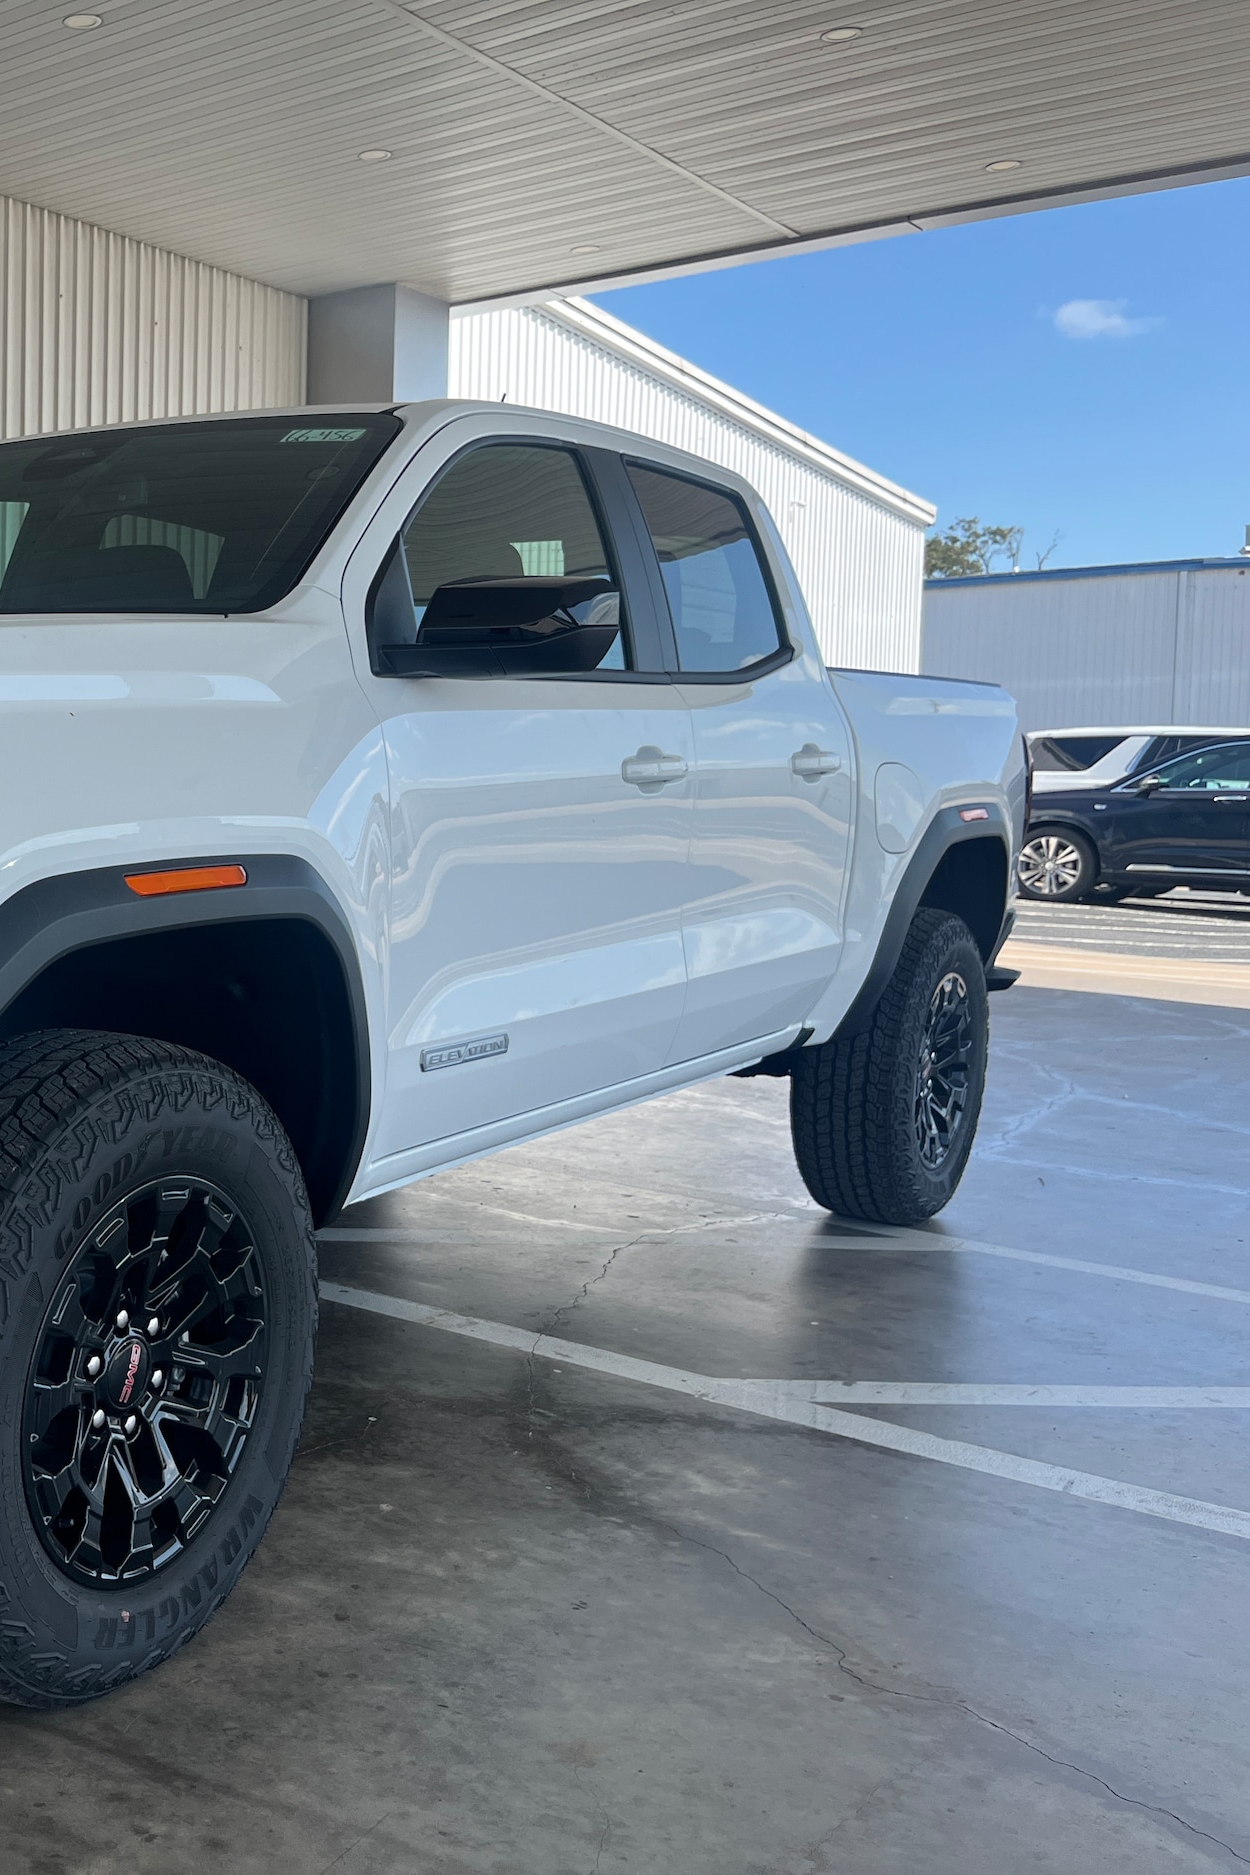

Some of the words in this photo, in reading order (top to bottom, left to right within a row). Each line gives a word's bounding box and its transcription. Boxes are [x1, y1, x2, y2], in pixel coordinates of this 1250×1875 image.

[428, 1040, 504, 1065] ELEVATION
[54, 1125, 239, 1260] GOODYEAR
[118, 1343, 141, 1403] GMC
[94, 1493, 265, 1651] WRANGLER
